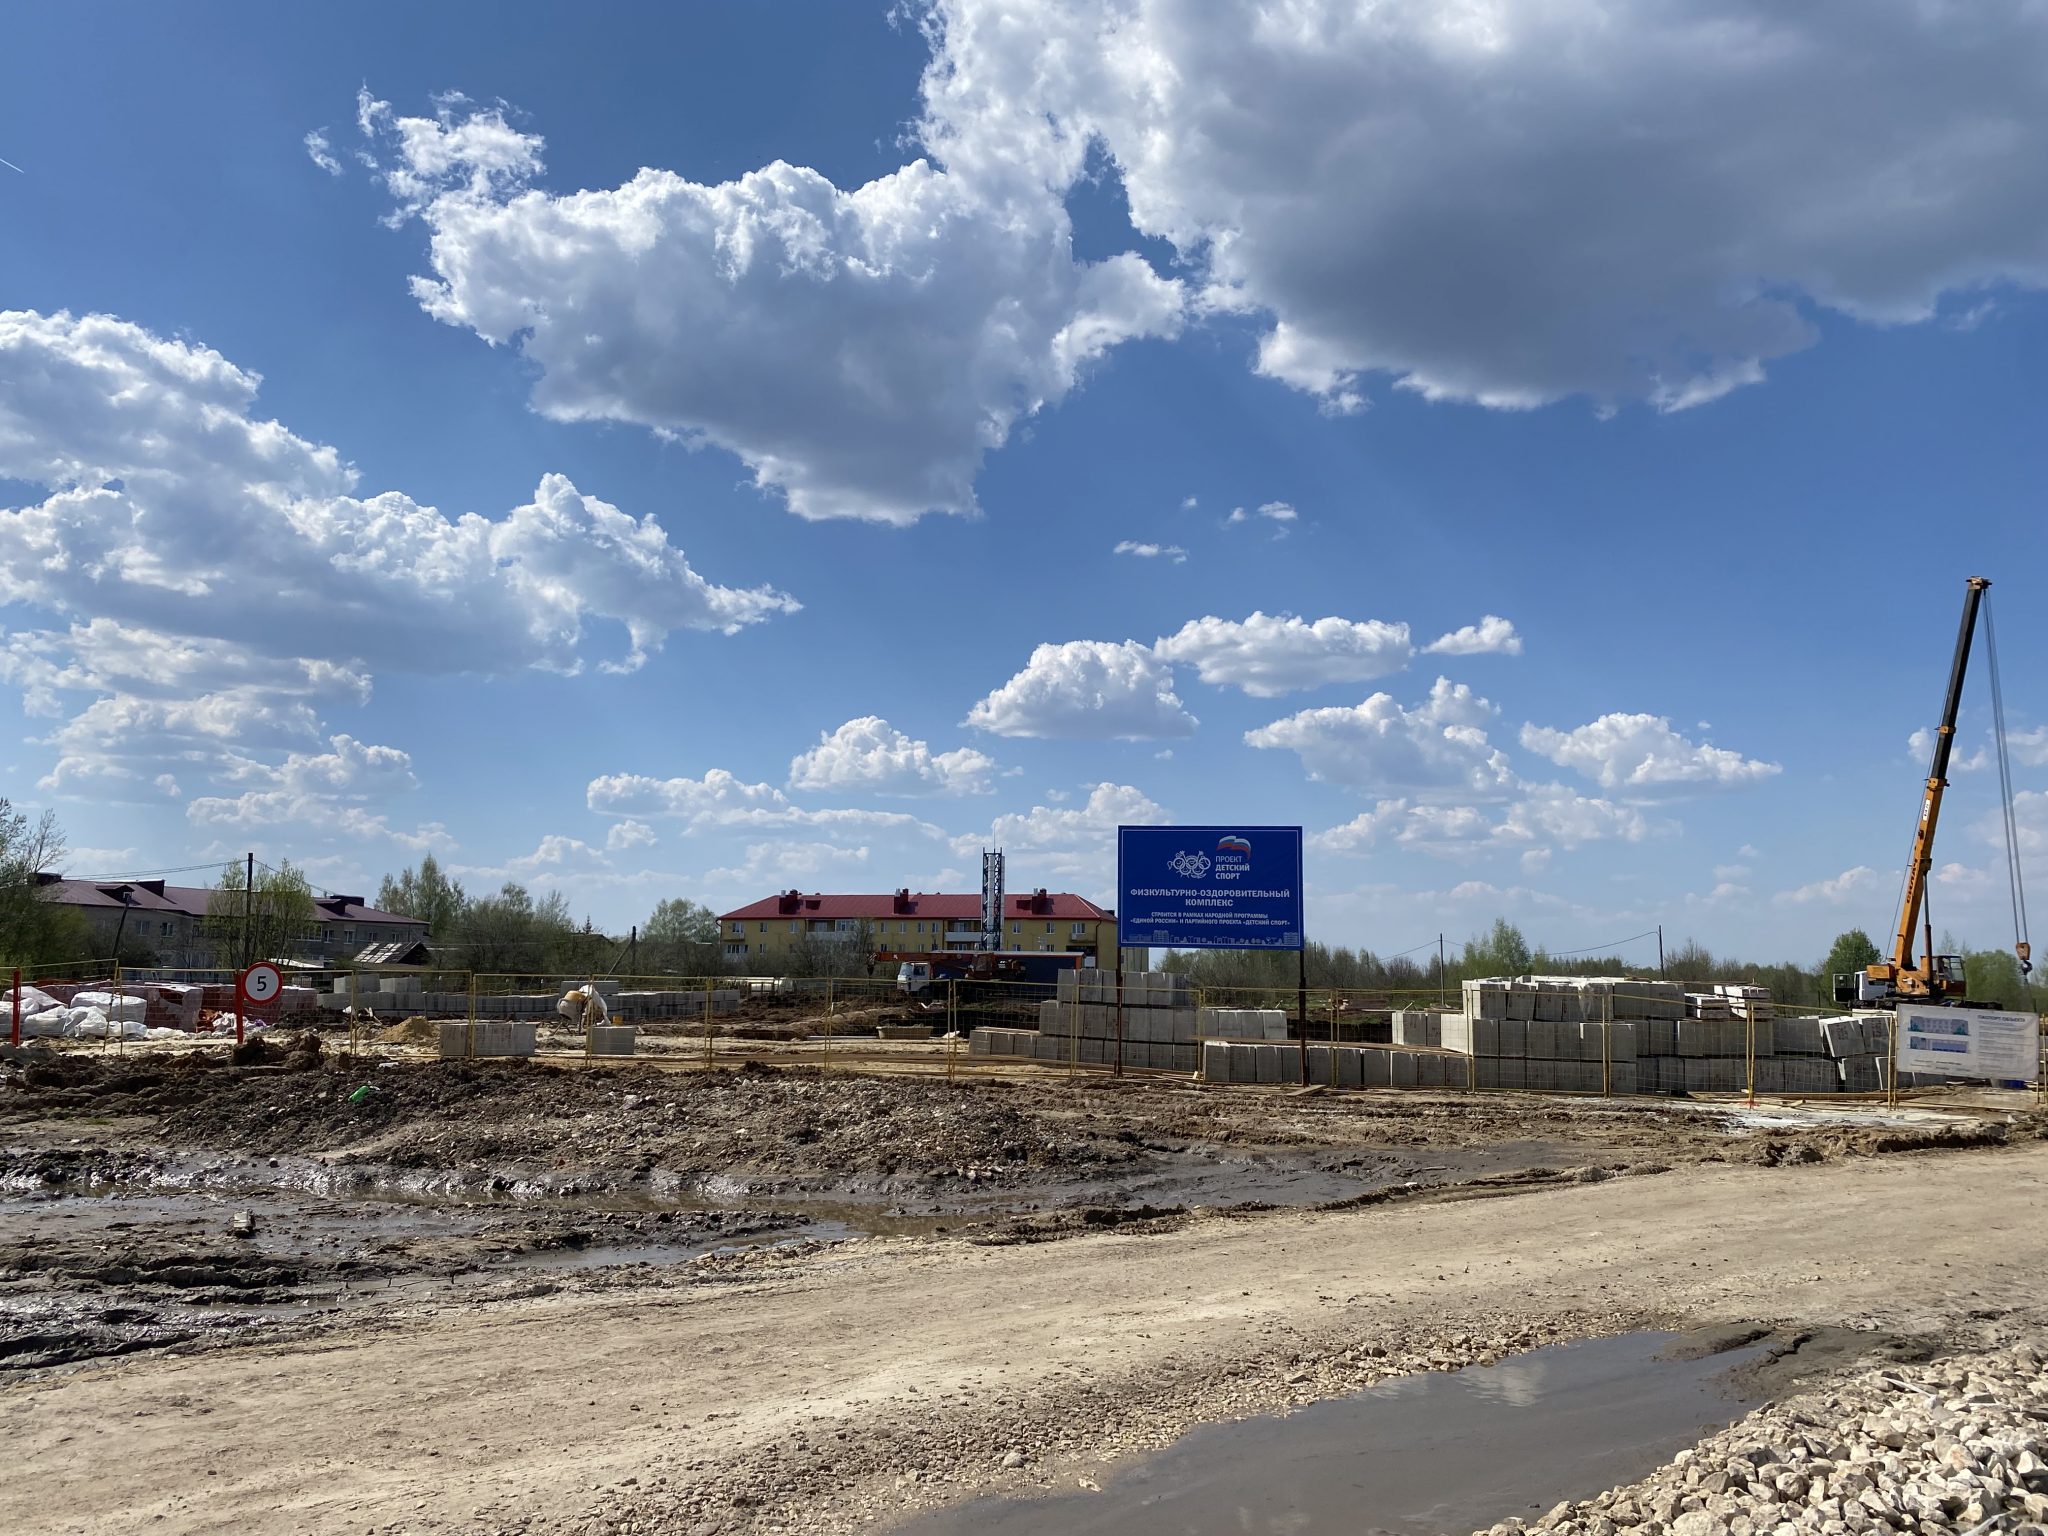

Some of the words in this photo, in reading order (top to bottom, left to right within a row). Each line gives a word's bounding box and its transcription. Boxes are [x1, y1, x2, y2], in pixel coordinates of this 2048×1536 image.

[1215, 855, 1243, 863] ПРОЕКТ
[1215, 863, 1250, 872] ДЕТСКИЙ
[1215, 872, 1241, 880] СПОРТ
[1130, 888, 1290, 898] ФИЗКУЛЬТУРНО-ОЗДОРОВИТЕЛЬНЫЙ
[1185, 898, 1234, 907] КОМПЛЕКС
[1205, 911, 1233, 919] НАРОДНОЙ
[256, 975, 267, 992] 5
